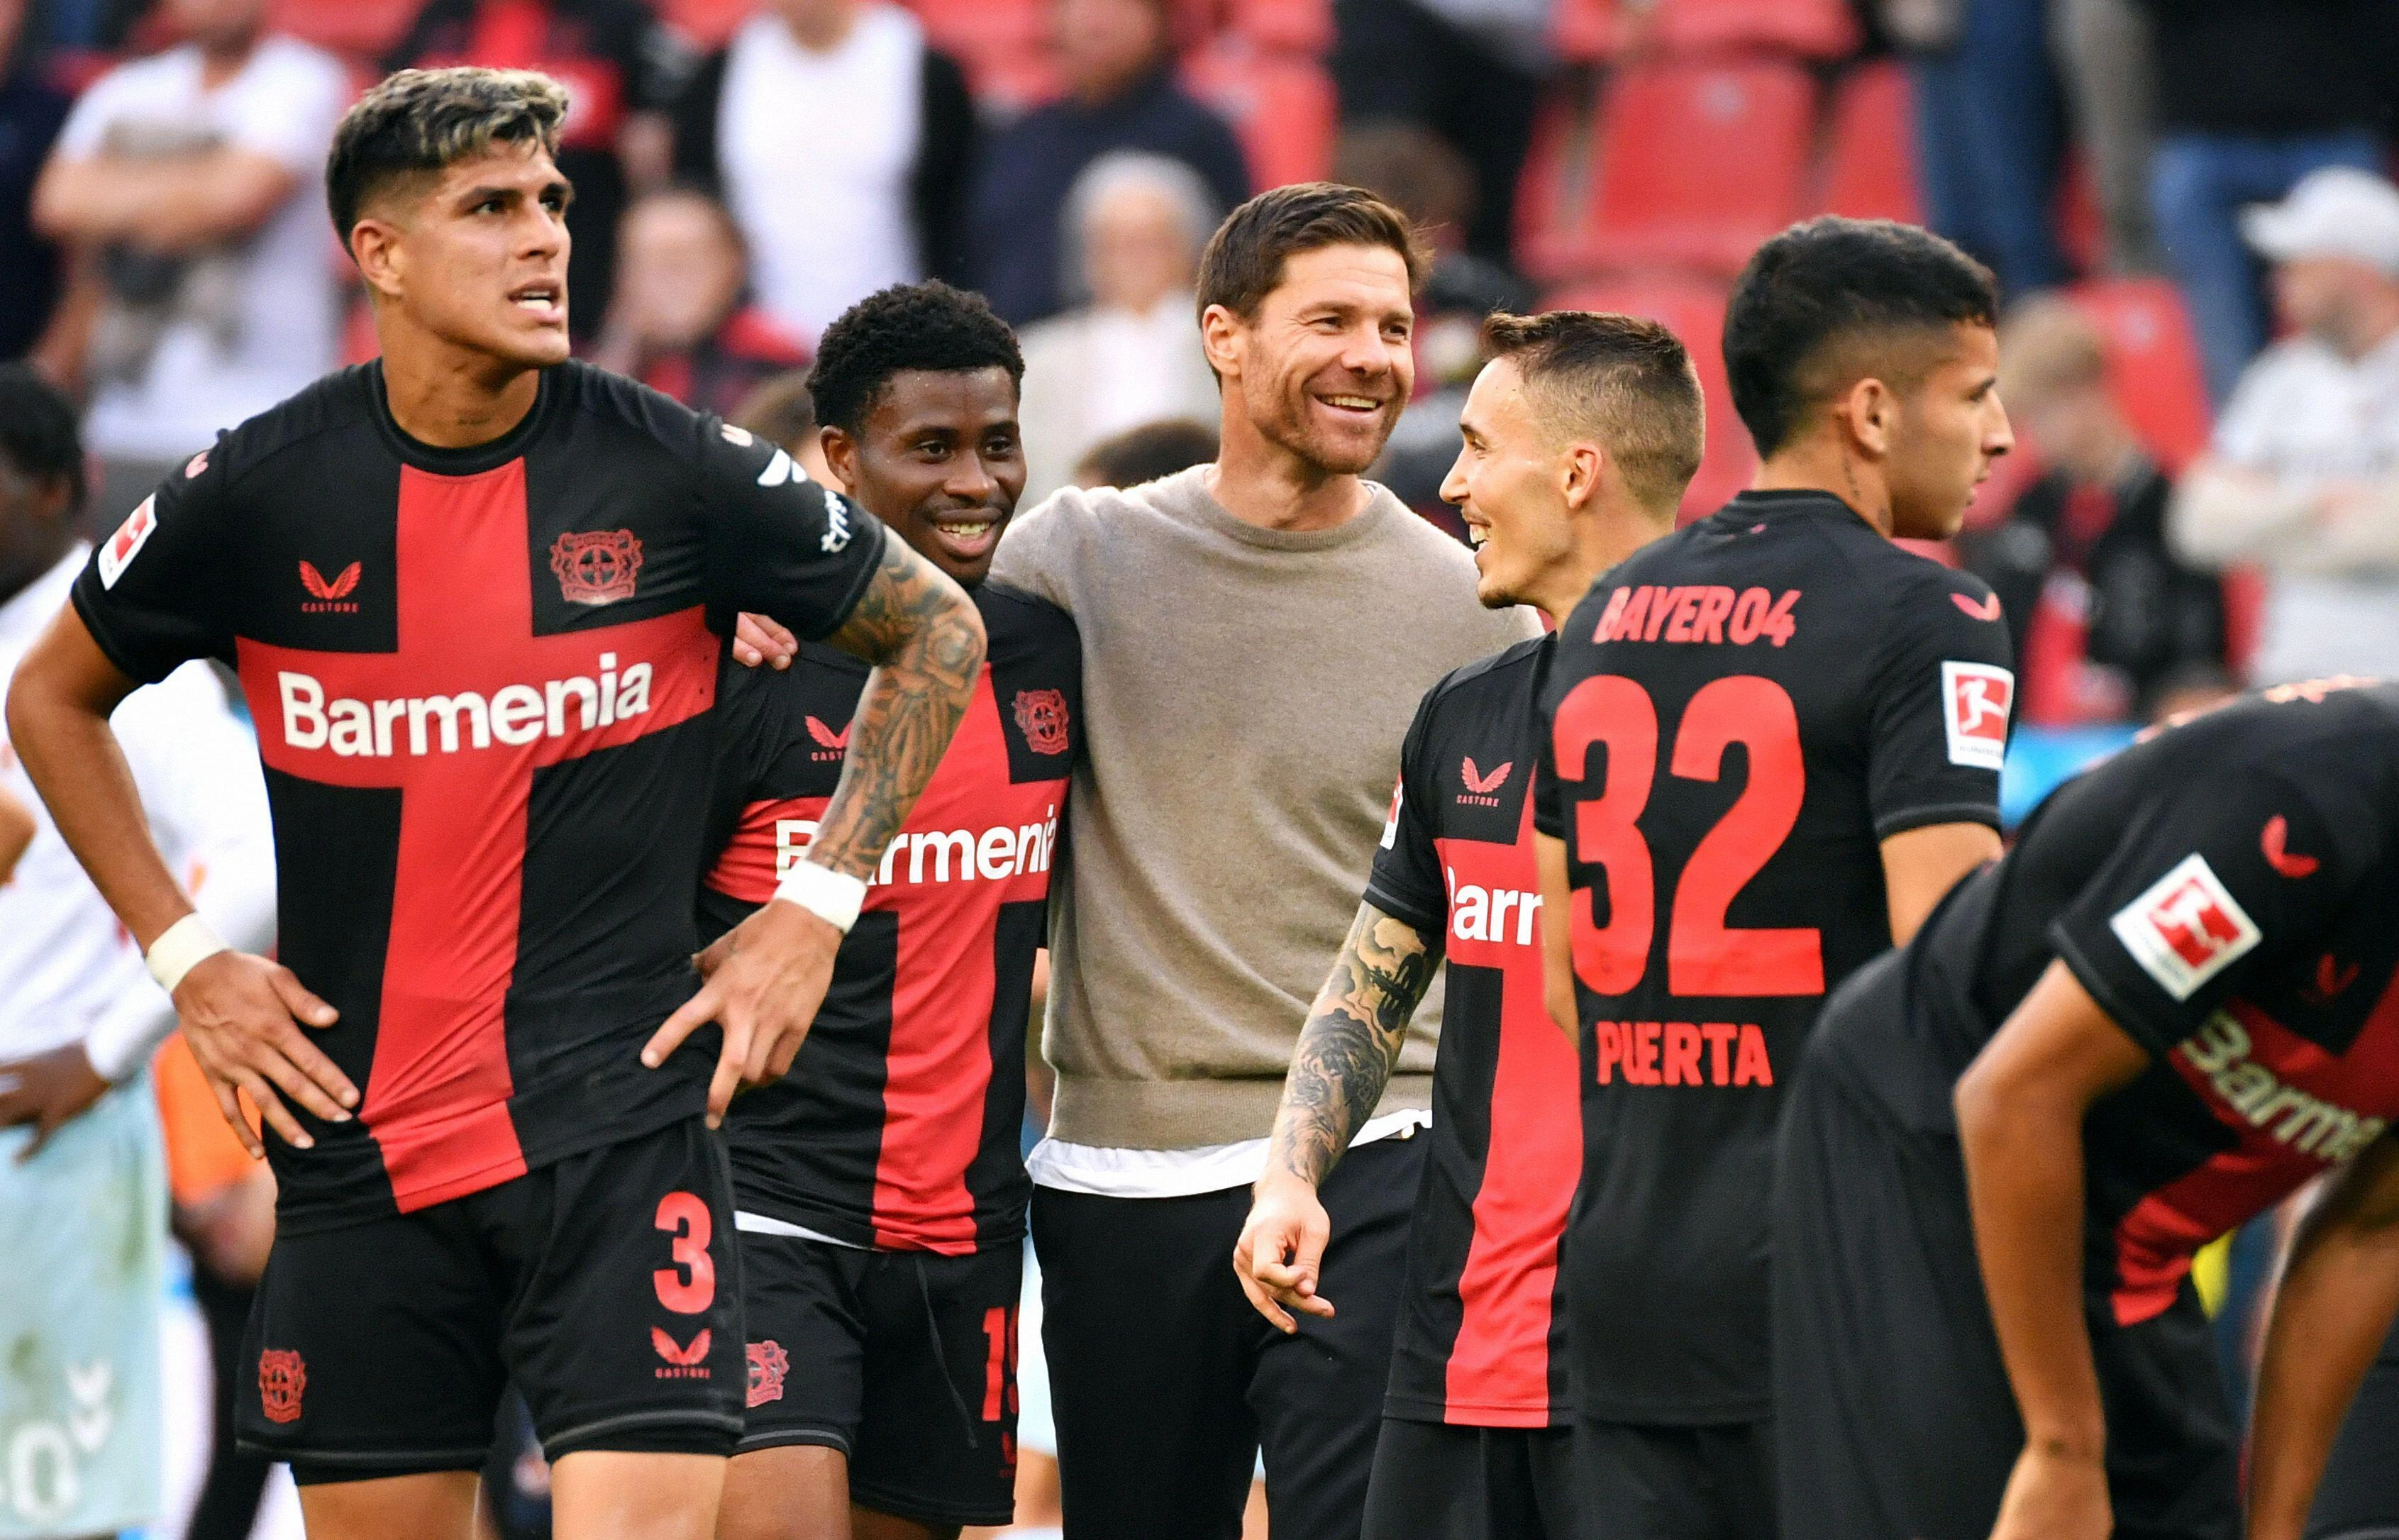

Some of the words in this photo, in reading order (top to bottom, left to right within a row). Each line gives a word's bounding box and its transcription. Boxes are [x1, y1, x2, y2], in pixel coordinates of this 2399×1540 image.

[279, 653, 652, 756] Barmenia
[811, 751, 843, 761] CAST
[1456, 794, 1500, 807] CASTORE
[1553, 674, 1825, 997] 32
[1595, 1021, 1773, 1087] PUERTA
[653, 1192, 715, 1314] 3
